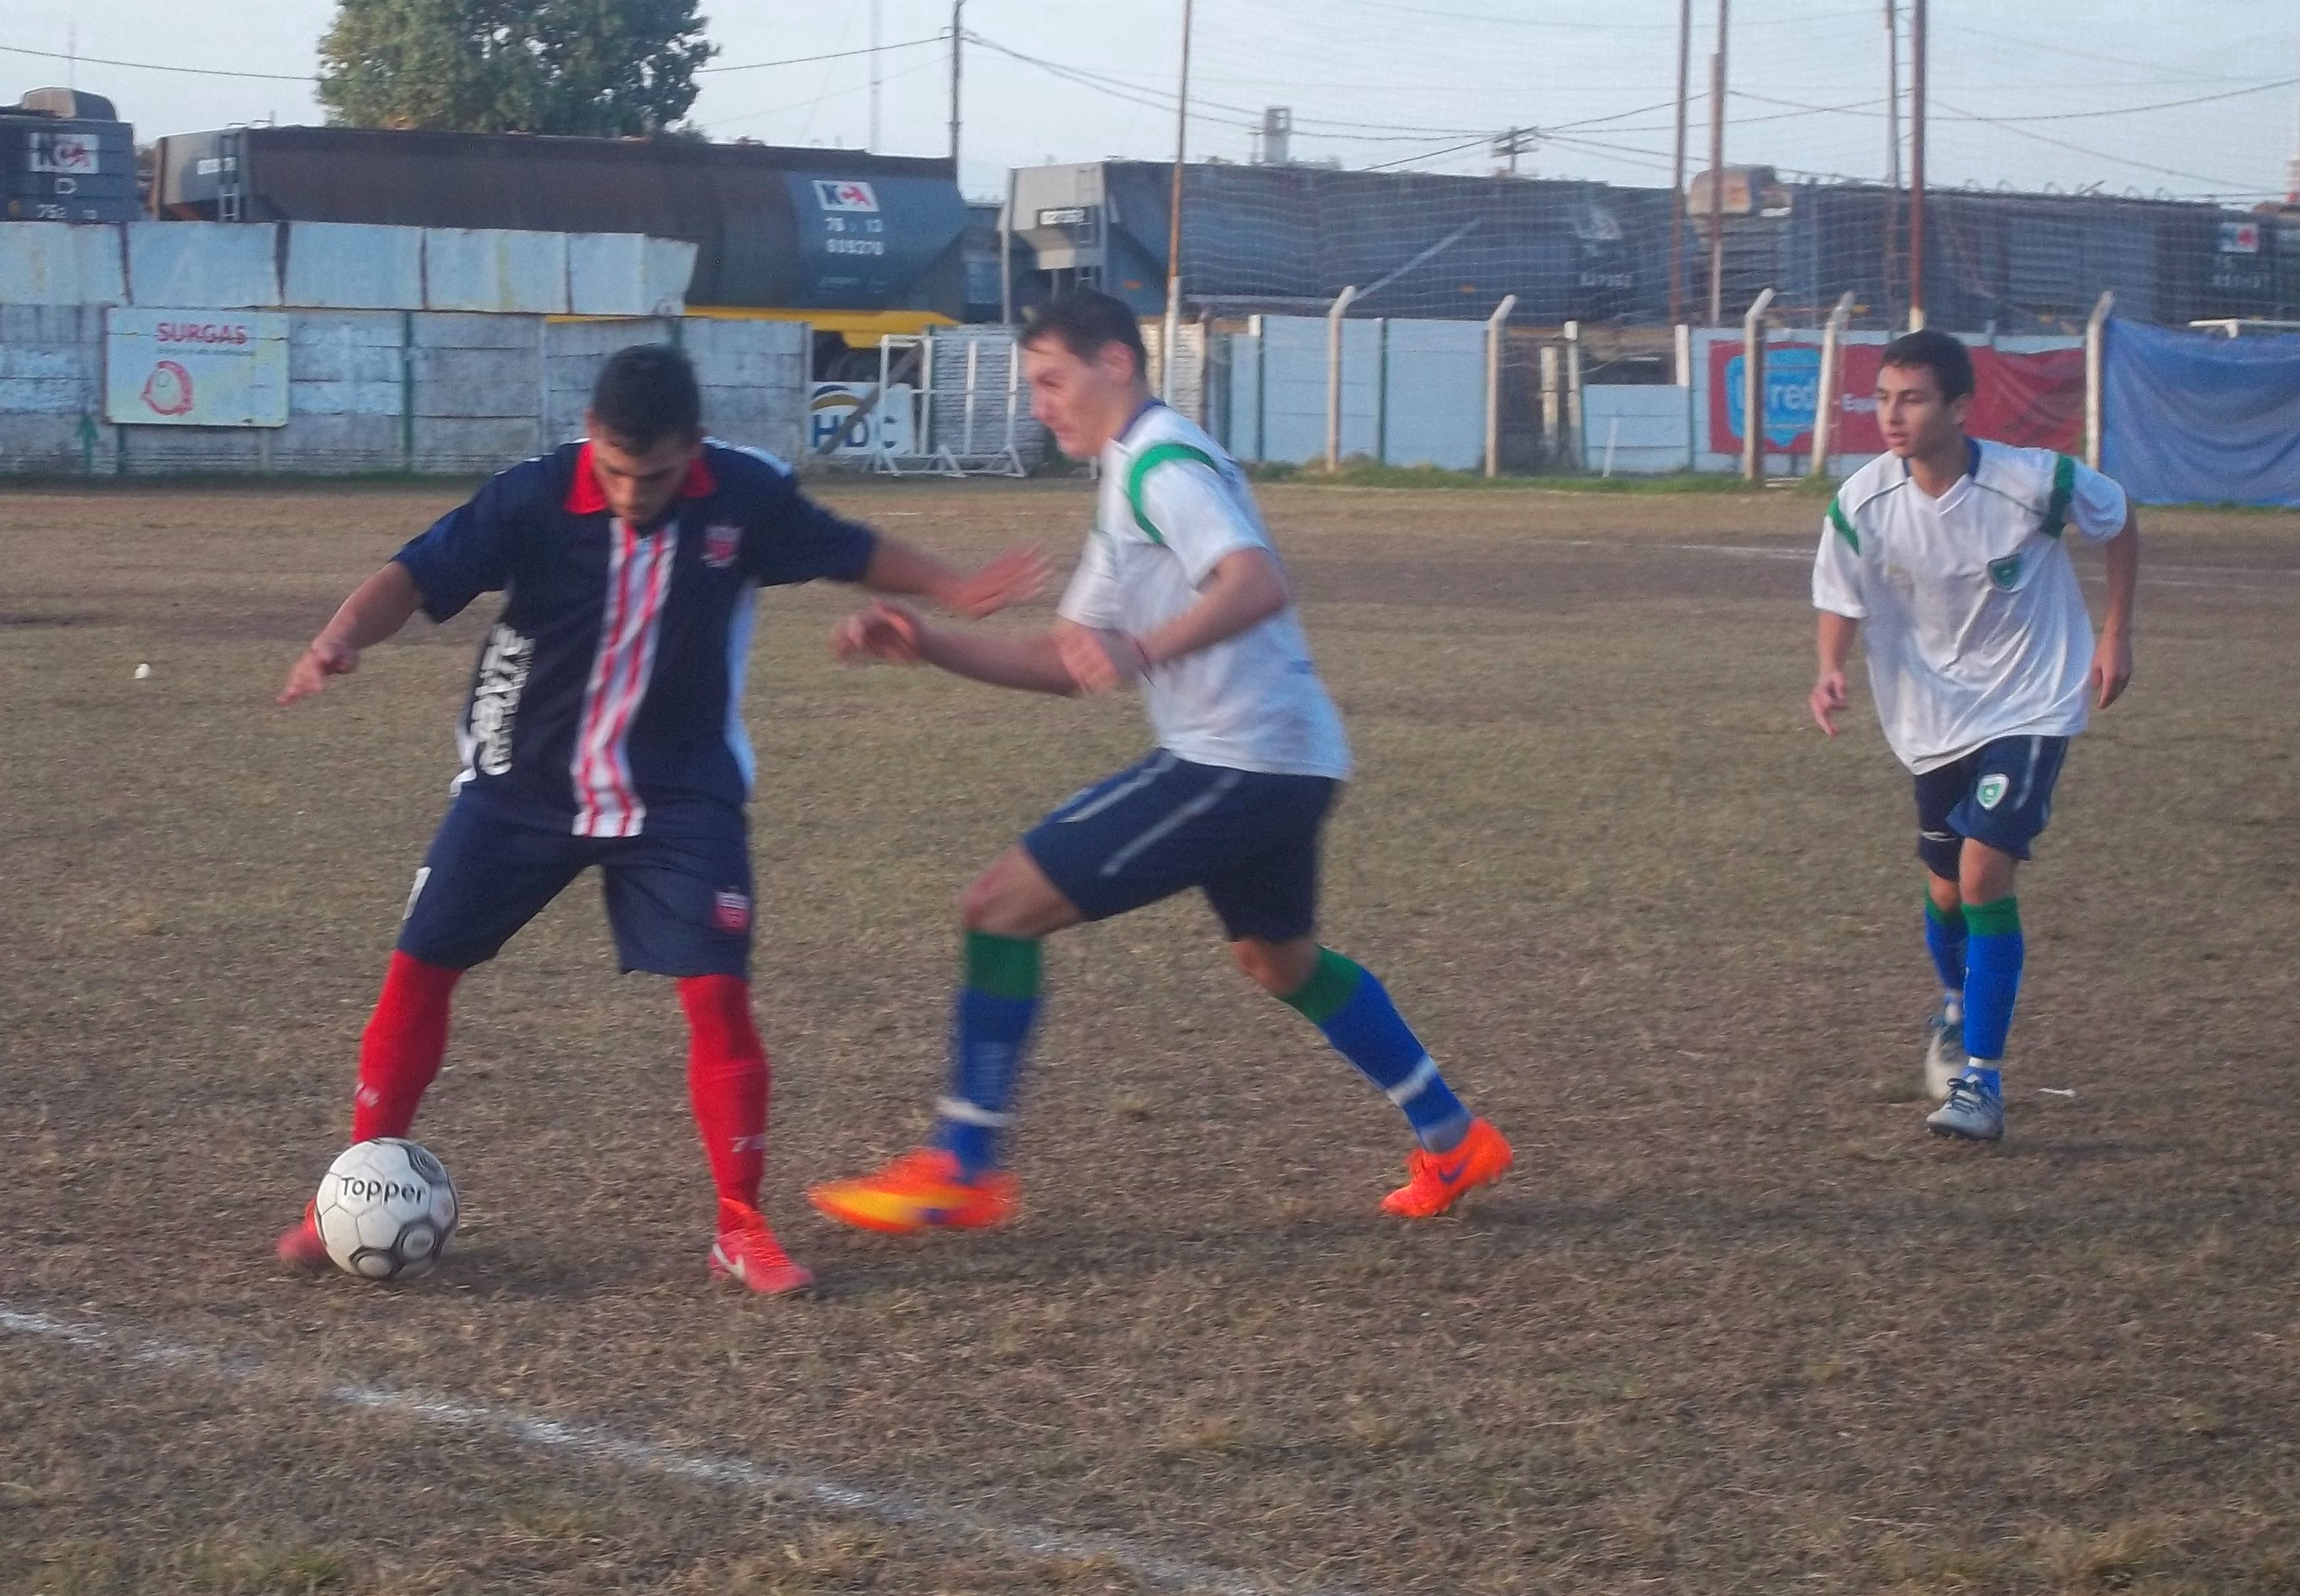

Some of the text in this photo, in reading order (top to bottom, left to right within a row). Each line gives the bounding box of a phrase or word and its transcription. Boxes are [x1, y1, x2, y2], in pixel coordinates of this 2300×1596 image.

[55, 178, 78, 194] D
[157, 322, 248, 345] SURGAS
[341, 1176, 426, 1205] Topper
